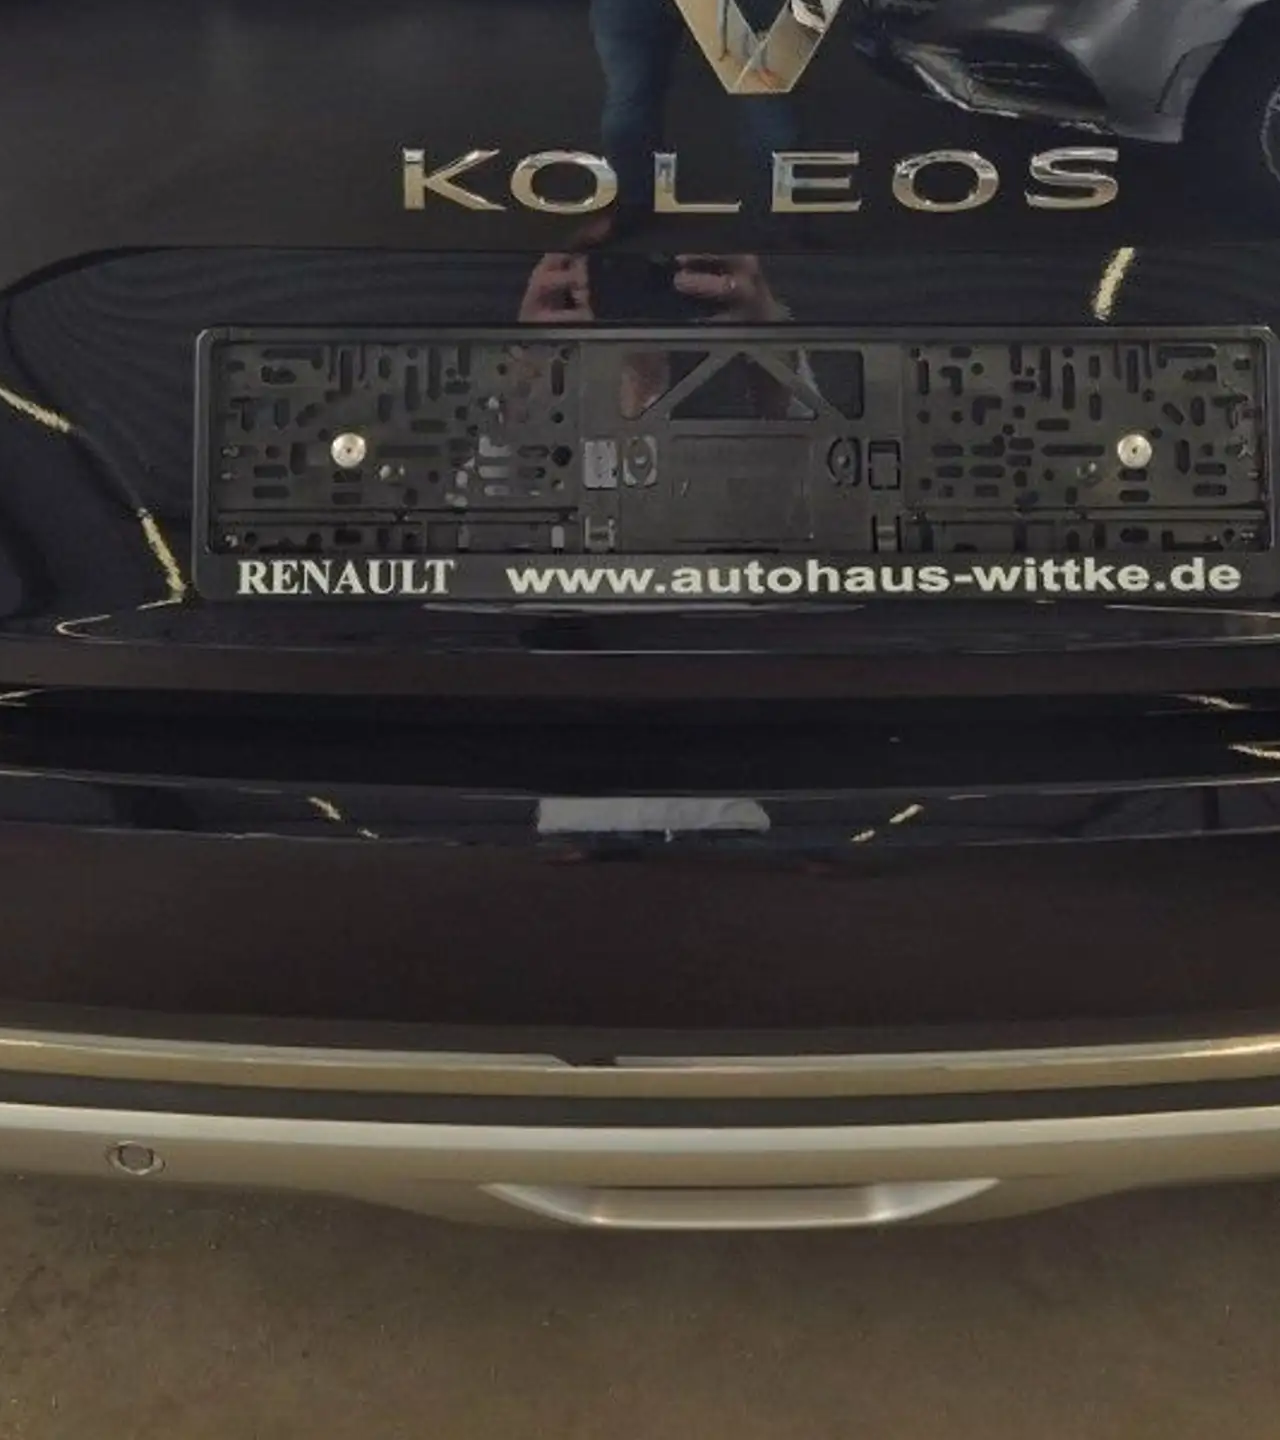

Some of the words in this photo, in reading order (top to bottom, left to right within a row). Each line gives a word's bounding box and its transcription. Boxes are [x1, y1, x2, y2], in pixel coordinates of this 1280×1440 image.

[401, 148, 1121, 214] KOLEOS
[237, 559, 455, 595] RENAULT
[506, 557, 1242, 594] www.autohaus-wittke.de
